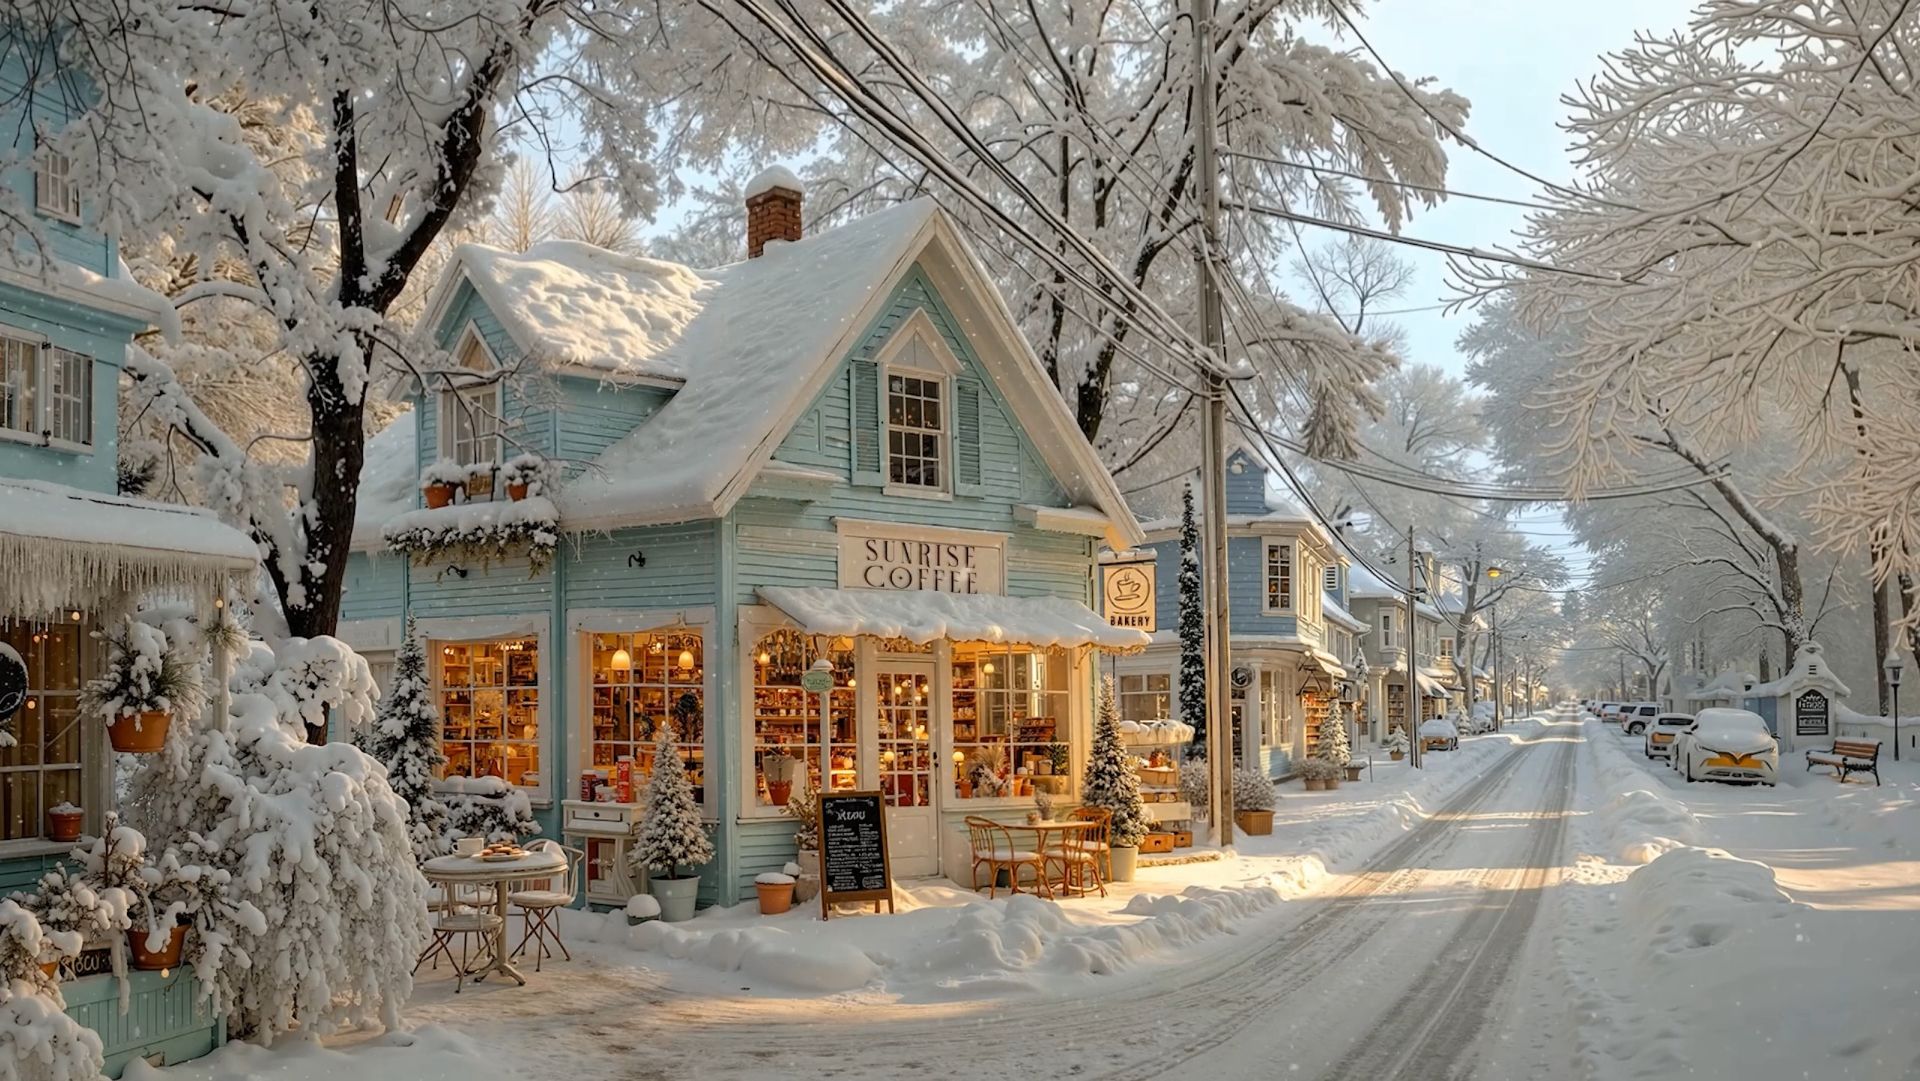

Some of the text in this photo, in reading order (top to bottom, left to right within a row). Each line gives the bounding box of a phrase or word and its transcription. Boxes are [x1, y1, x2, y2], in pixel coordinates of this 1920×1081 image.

[865, 539, 977, 569] SUNRISE
[863, 564, 978, 595] COFFEE
[1110, 615, 1150, 627] BAKERY
